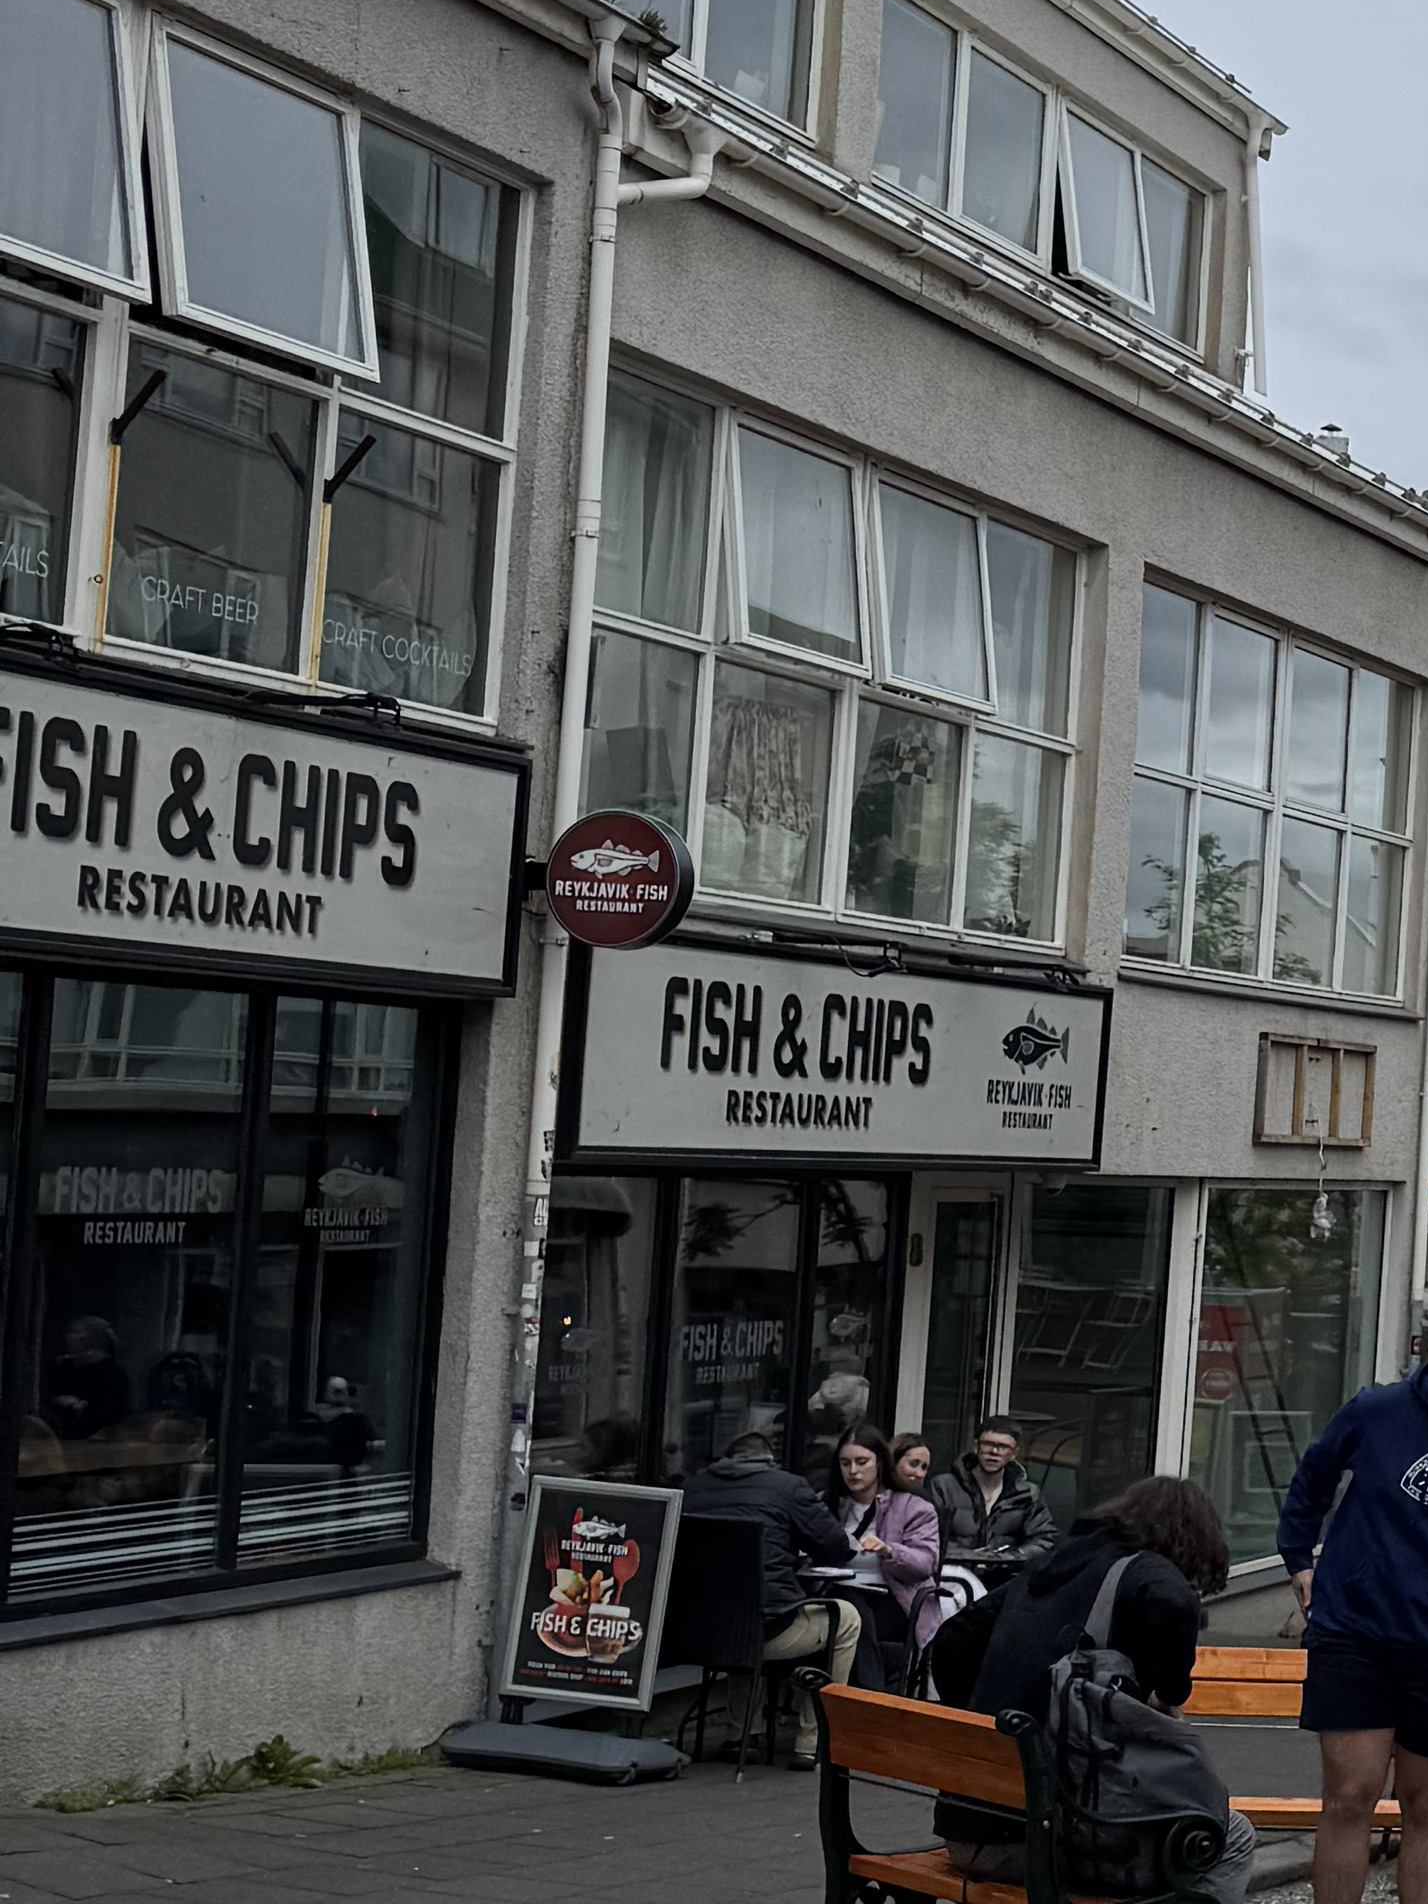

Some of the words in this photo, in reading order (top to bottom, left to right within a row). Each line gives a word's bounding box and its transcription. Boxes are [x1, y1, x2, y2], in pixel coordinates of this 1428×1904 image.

[0, 542, 49, 578] AILS
[141, 576, 206, 613] CRAFT
[211, 593, 259, 625] BEER
[321, 619, 377, 652] CRAFT
[381, 635, 473, 679] COCKTAILS
[157, 747, 215, 861] &
[233, 753, 419, 887] CHIPS
[77, 865, 322, 935] RESTAURANT
[555, 880, 629, 899] REYKJAVIK
[636, 885, 668, 901] FISH
[576, 900, 644, 913] RESTAURANT
[660, 976, 763, 1074] FISH
[773, 992, 808, 1078] &
[819, 993, 933, 1086] CHIPS
[726, 1089, 873, 1130] RESTAURANT
[987, 1079, 1044, 1107] REYKJAVIK
[1047, 1084, 1071, 1110] FISH
[1001, 1110, 1053, 1130] RESTAURANT
[54, 1166, 117, 1213] FISH
[123, 1172, 142, 1209] &
[147, 1167, 226, 1213] CHIPS
[84, 1221, 186, 1244] RESTAURANT
[364, 1207, 389, 1226] FISH
[681, 1323, 718, 1362] FISH
[721, 1328, 733, 1356] &
[735, 1320, 784, 1357] CHIPS
[531, 1612, 566, 1633] FISH
[587, 1618, 641, 1641] CHIPS
